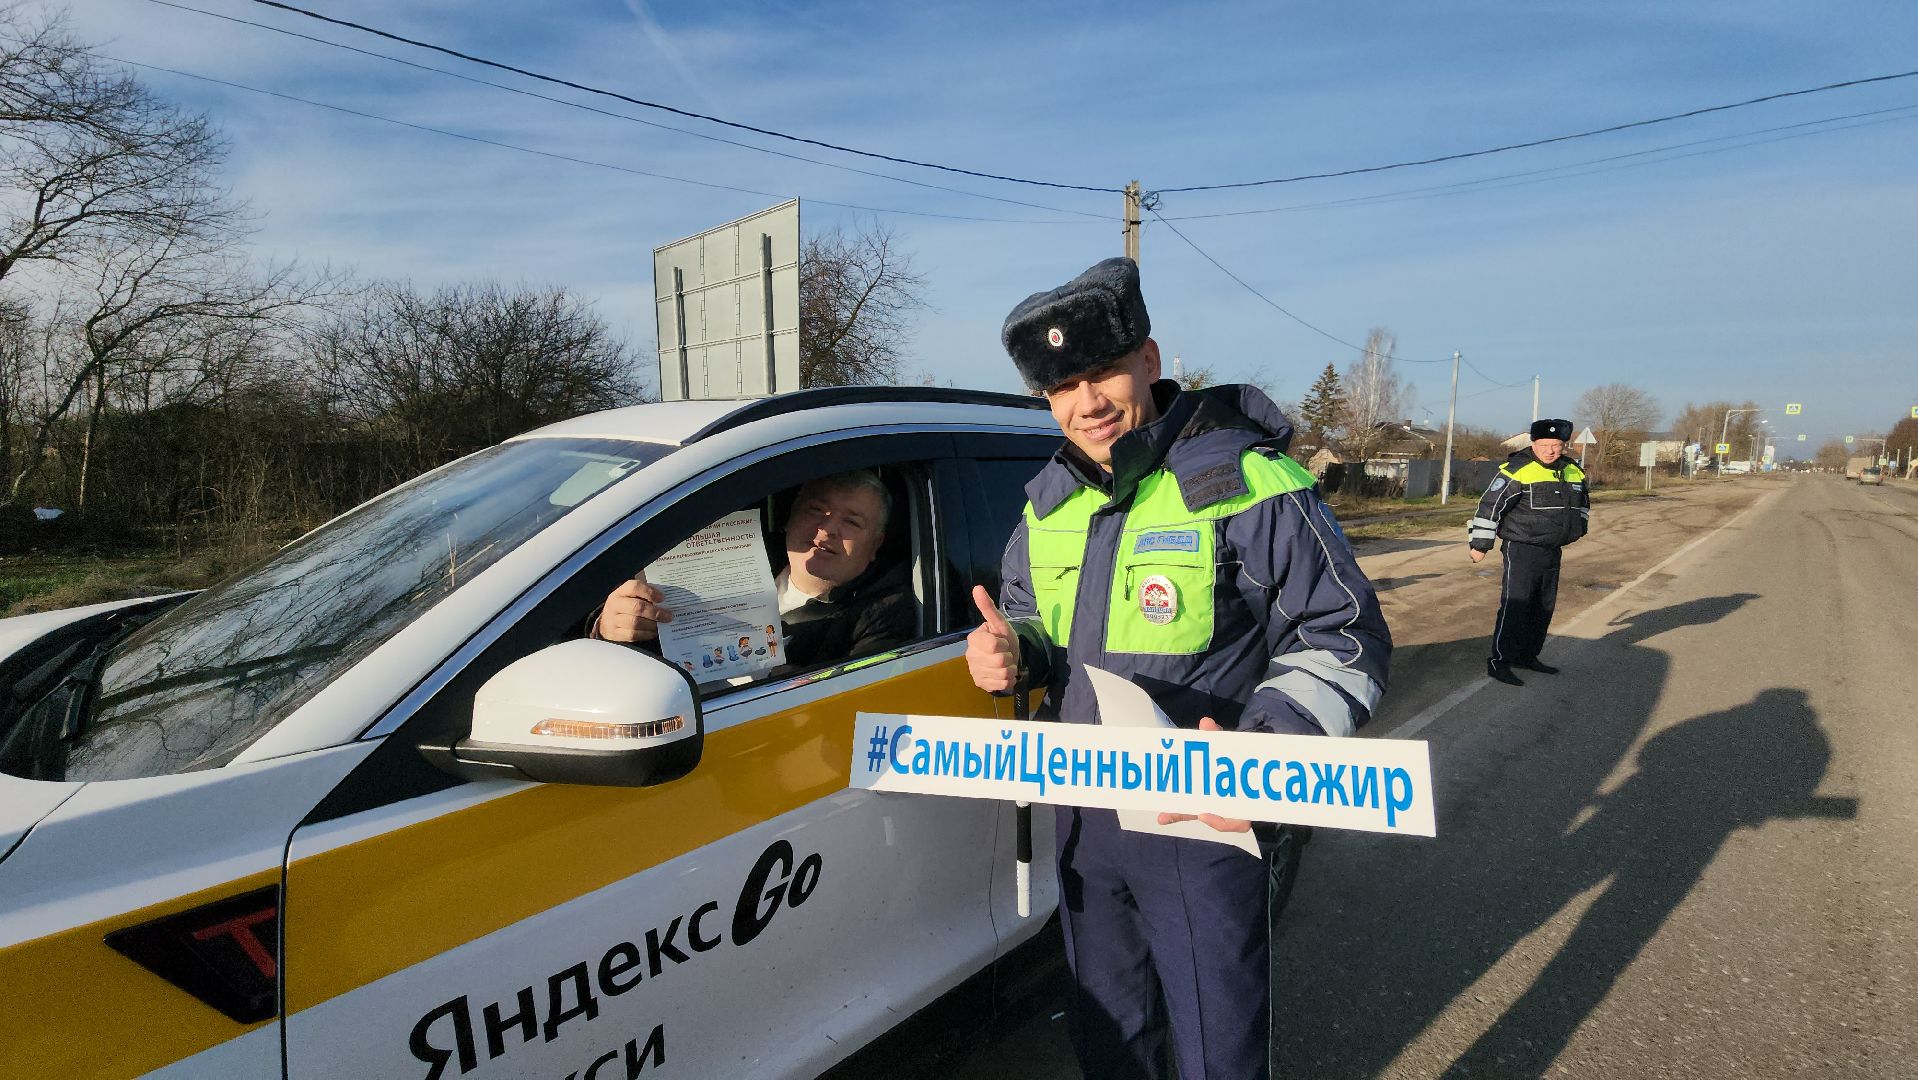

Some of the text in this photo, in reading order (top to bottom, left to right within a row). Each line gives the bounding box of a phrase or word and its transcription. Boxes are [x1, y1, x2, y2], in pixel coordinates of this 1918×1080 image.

[867, 724, 1414, 828] #СамыйЦенныйПассажир
[409, 839, 823, 1080] Яндекс Go
[564, 1023, 666, 1080] си
